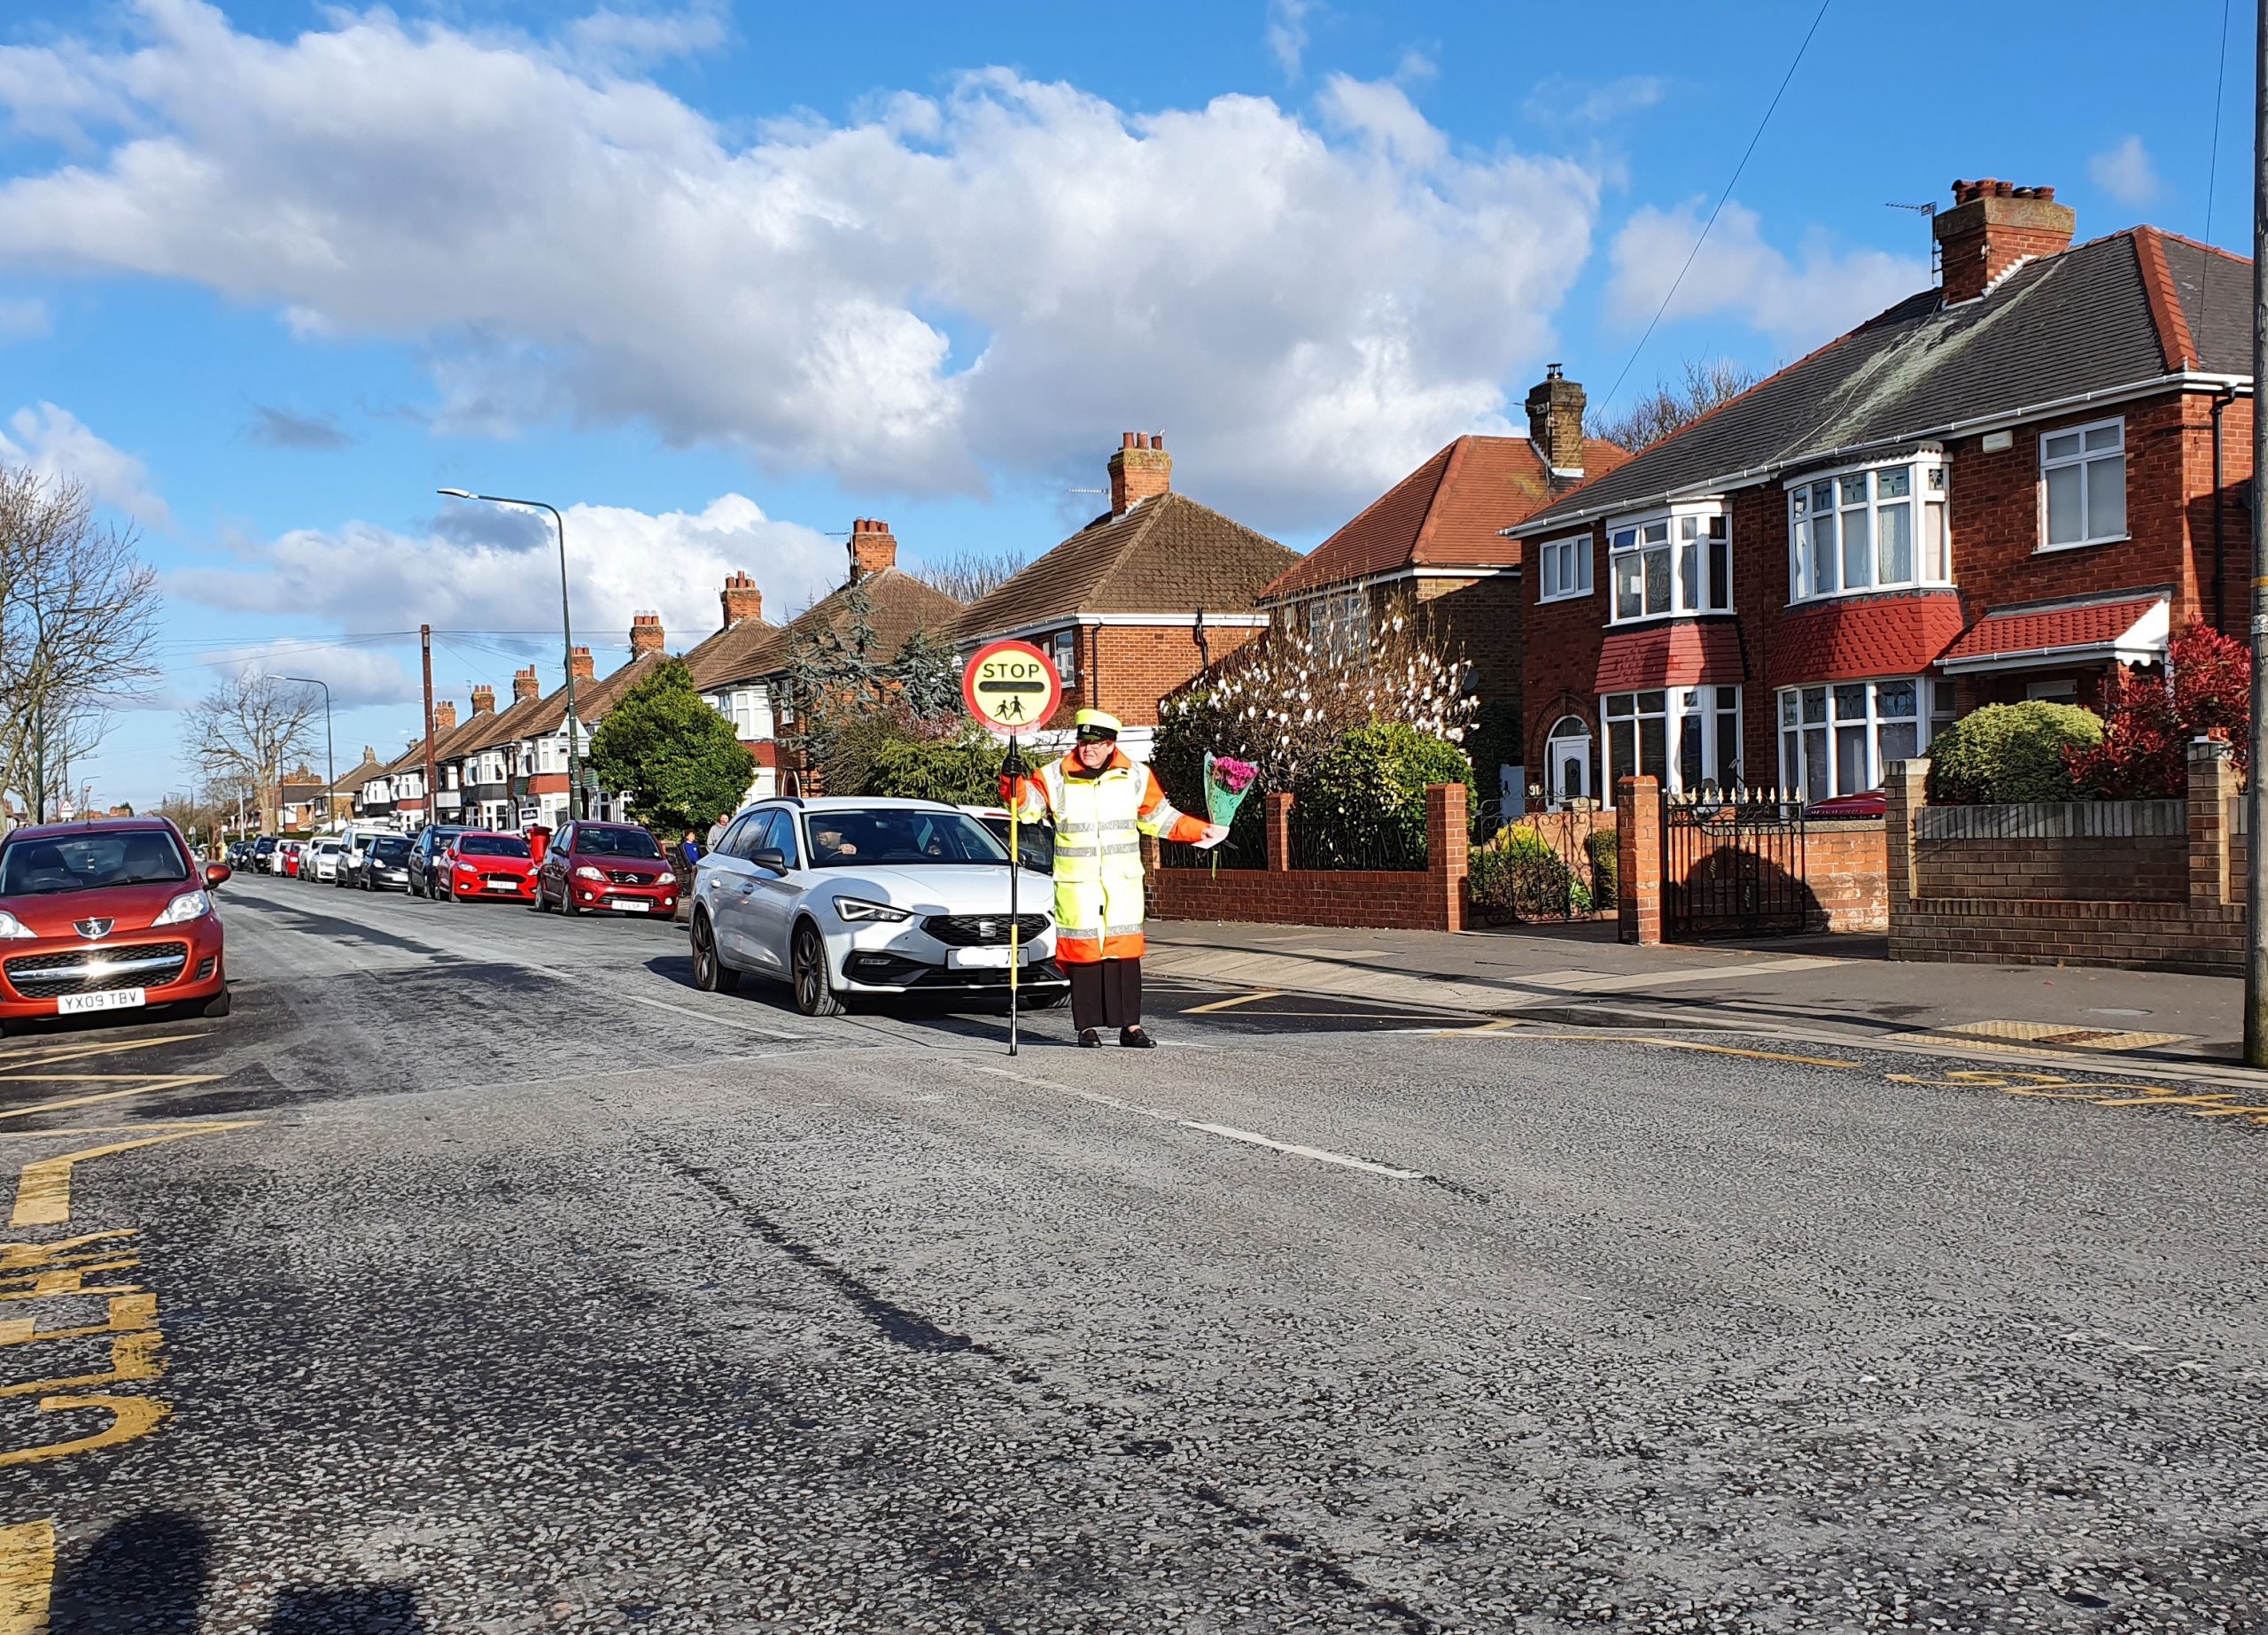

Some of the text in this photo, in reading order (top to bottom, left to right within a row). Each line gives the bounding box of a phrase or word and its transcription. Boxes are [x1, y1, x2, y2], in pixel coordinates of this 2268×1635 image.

[983, 663, 1039, 678] STOP
[65, 991, 136, 1009] YX09 TBV
